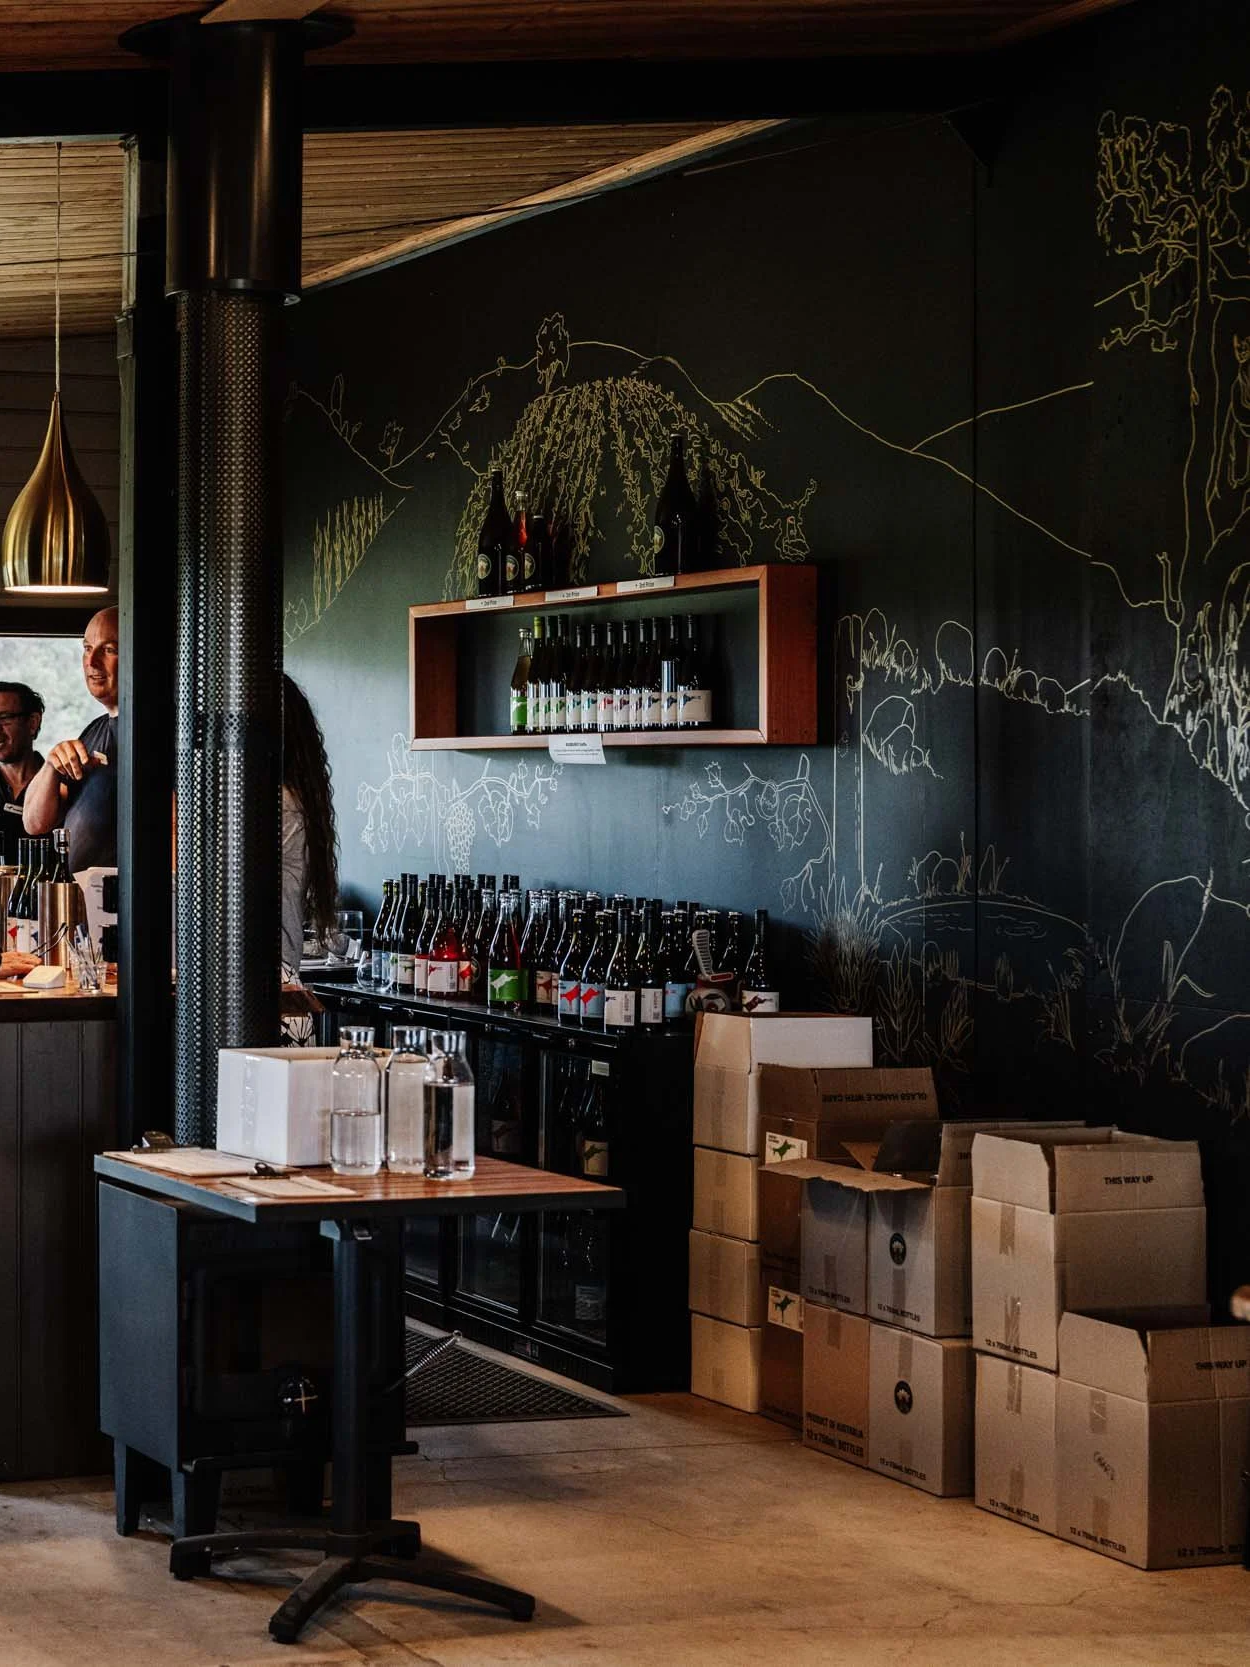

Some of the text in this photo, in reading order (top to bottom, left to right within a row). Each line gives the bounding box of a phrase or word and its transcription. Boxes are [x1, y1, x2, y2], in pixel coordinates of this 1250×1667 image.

[1104, 1175, 1154, 1185] THIS WAY UP
[1014, 1345, 1038, 1359] BOTTLES
[829, 1419, 835, 1429] OF
[838, 1440, 864, 1457] BOTTLES
[904, 1465, 927, 1481] BOTTLES
[1016, 1508, 1039, 1522] BOTTLES
[1100, 1537, 1127, 1554] BOTTLES
